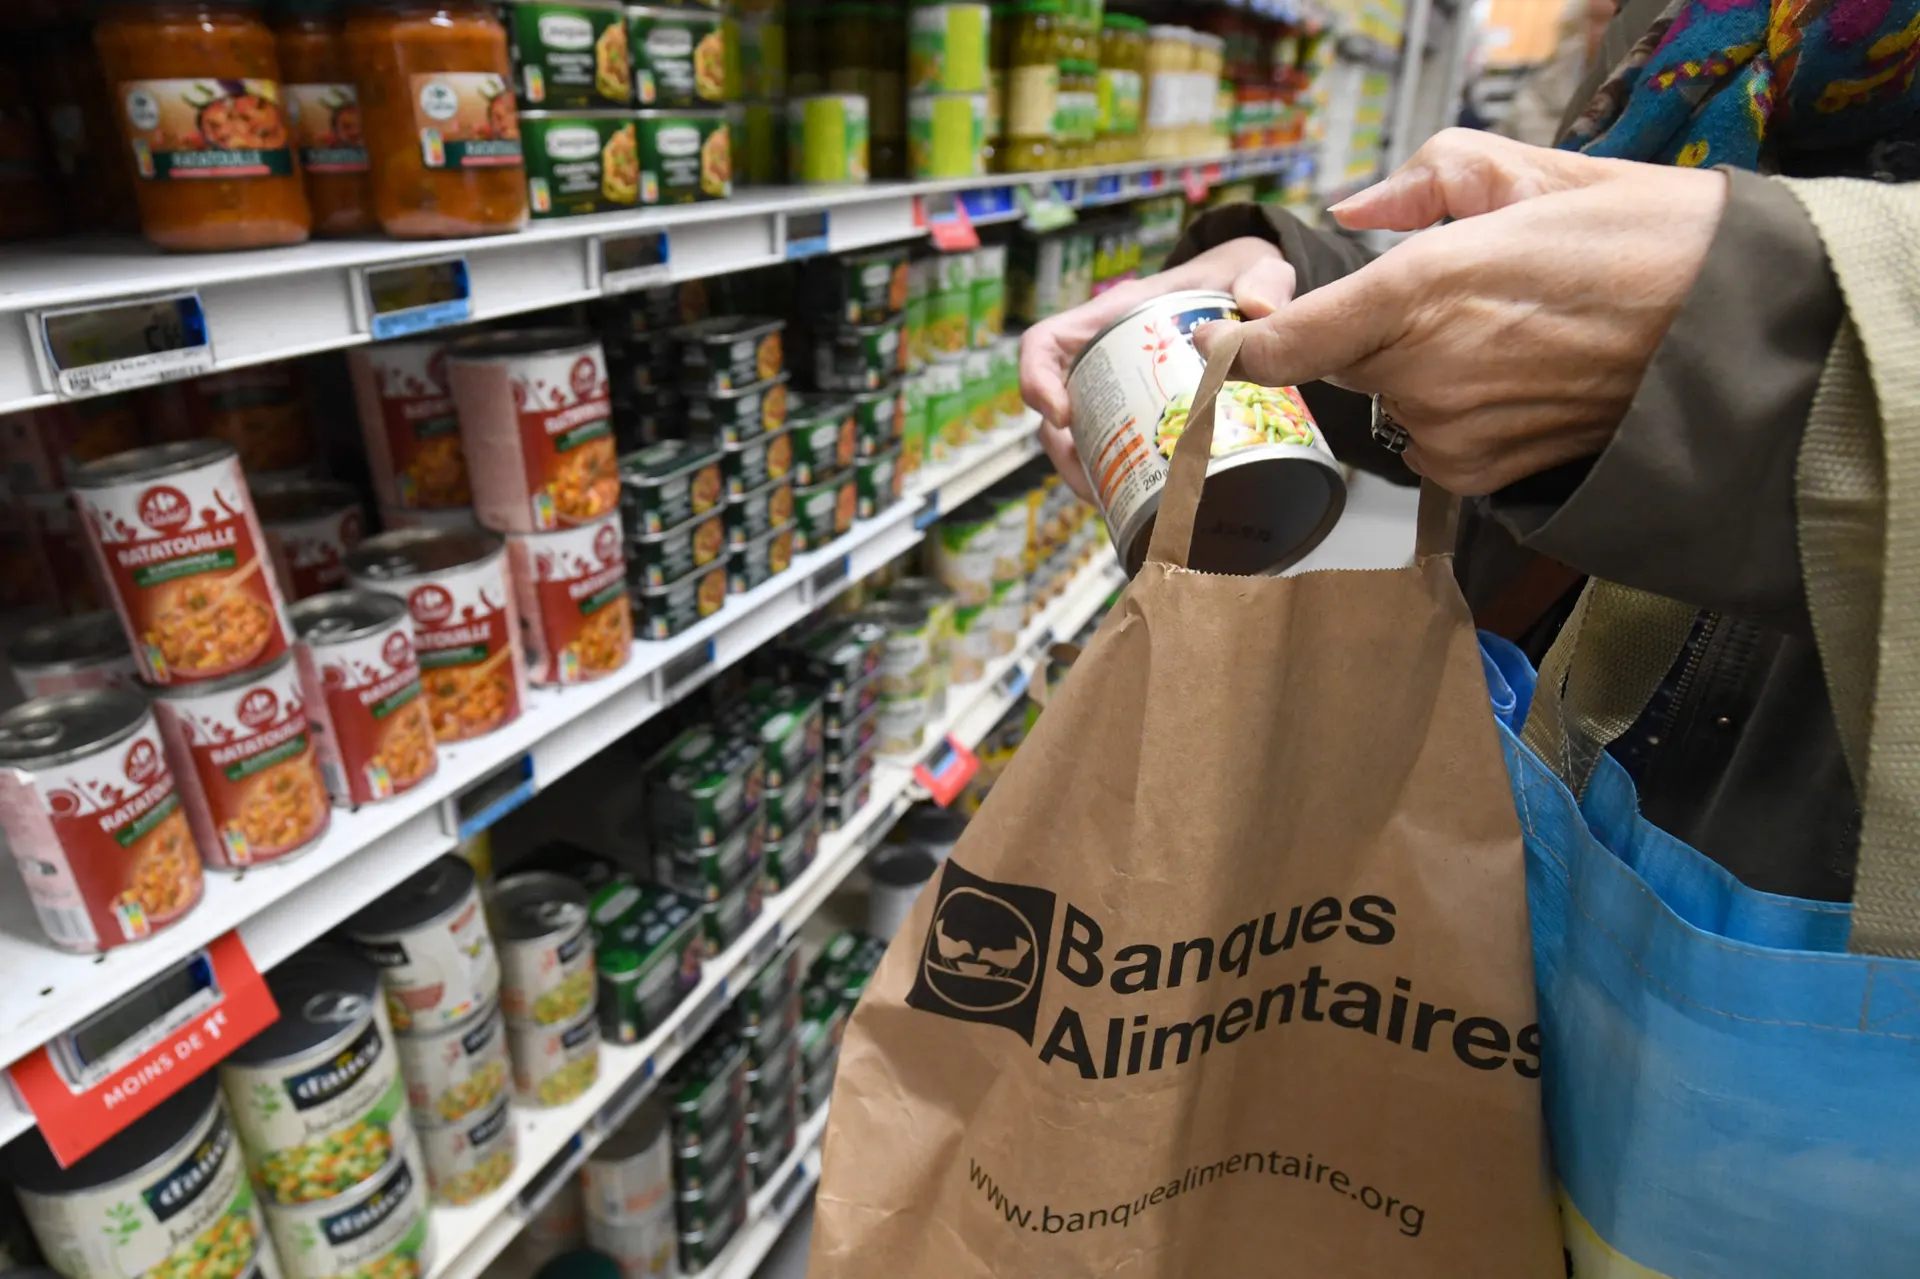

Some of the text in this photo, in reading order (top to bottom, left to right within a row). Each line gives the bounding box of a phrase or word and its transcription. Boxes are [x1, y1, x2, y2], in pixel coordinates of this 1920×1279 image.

[1142, 469, 1162, 492] 290
[116, 526, 236, 568] RATATOUILLE
[1057, 894, 1397, 996] Banques
[1038, 966, 1542, 1080] Alimentaires
[103, 1053, 174, 1110] MOINS
[174, 1032, 205, 1060] DE
[968, 1150, 1426, 1237] www.banquealimentaire.org
